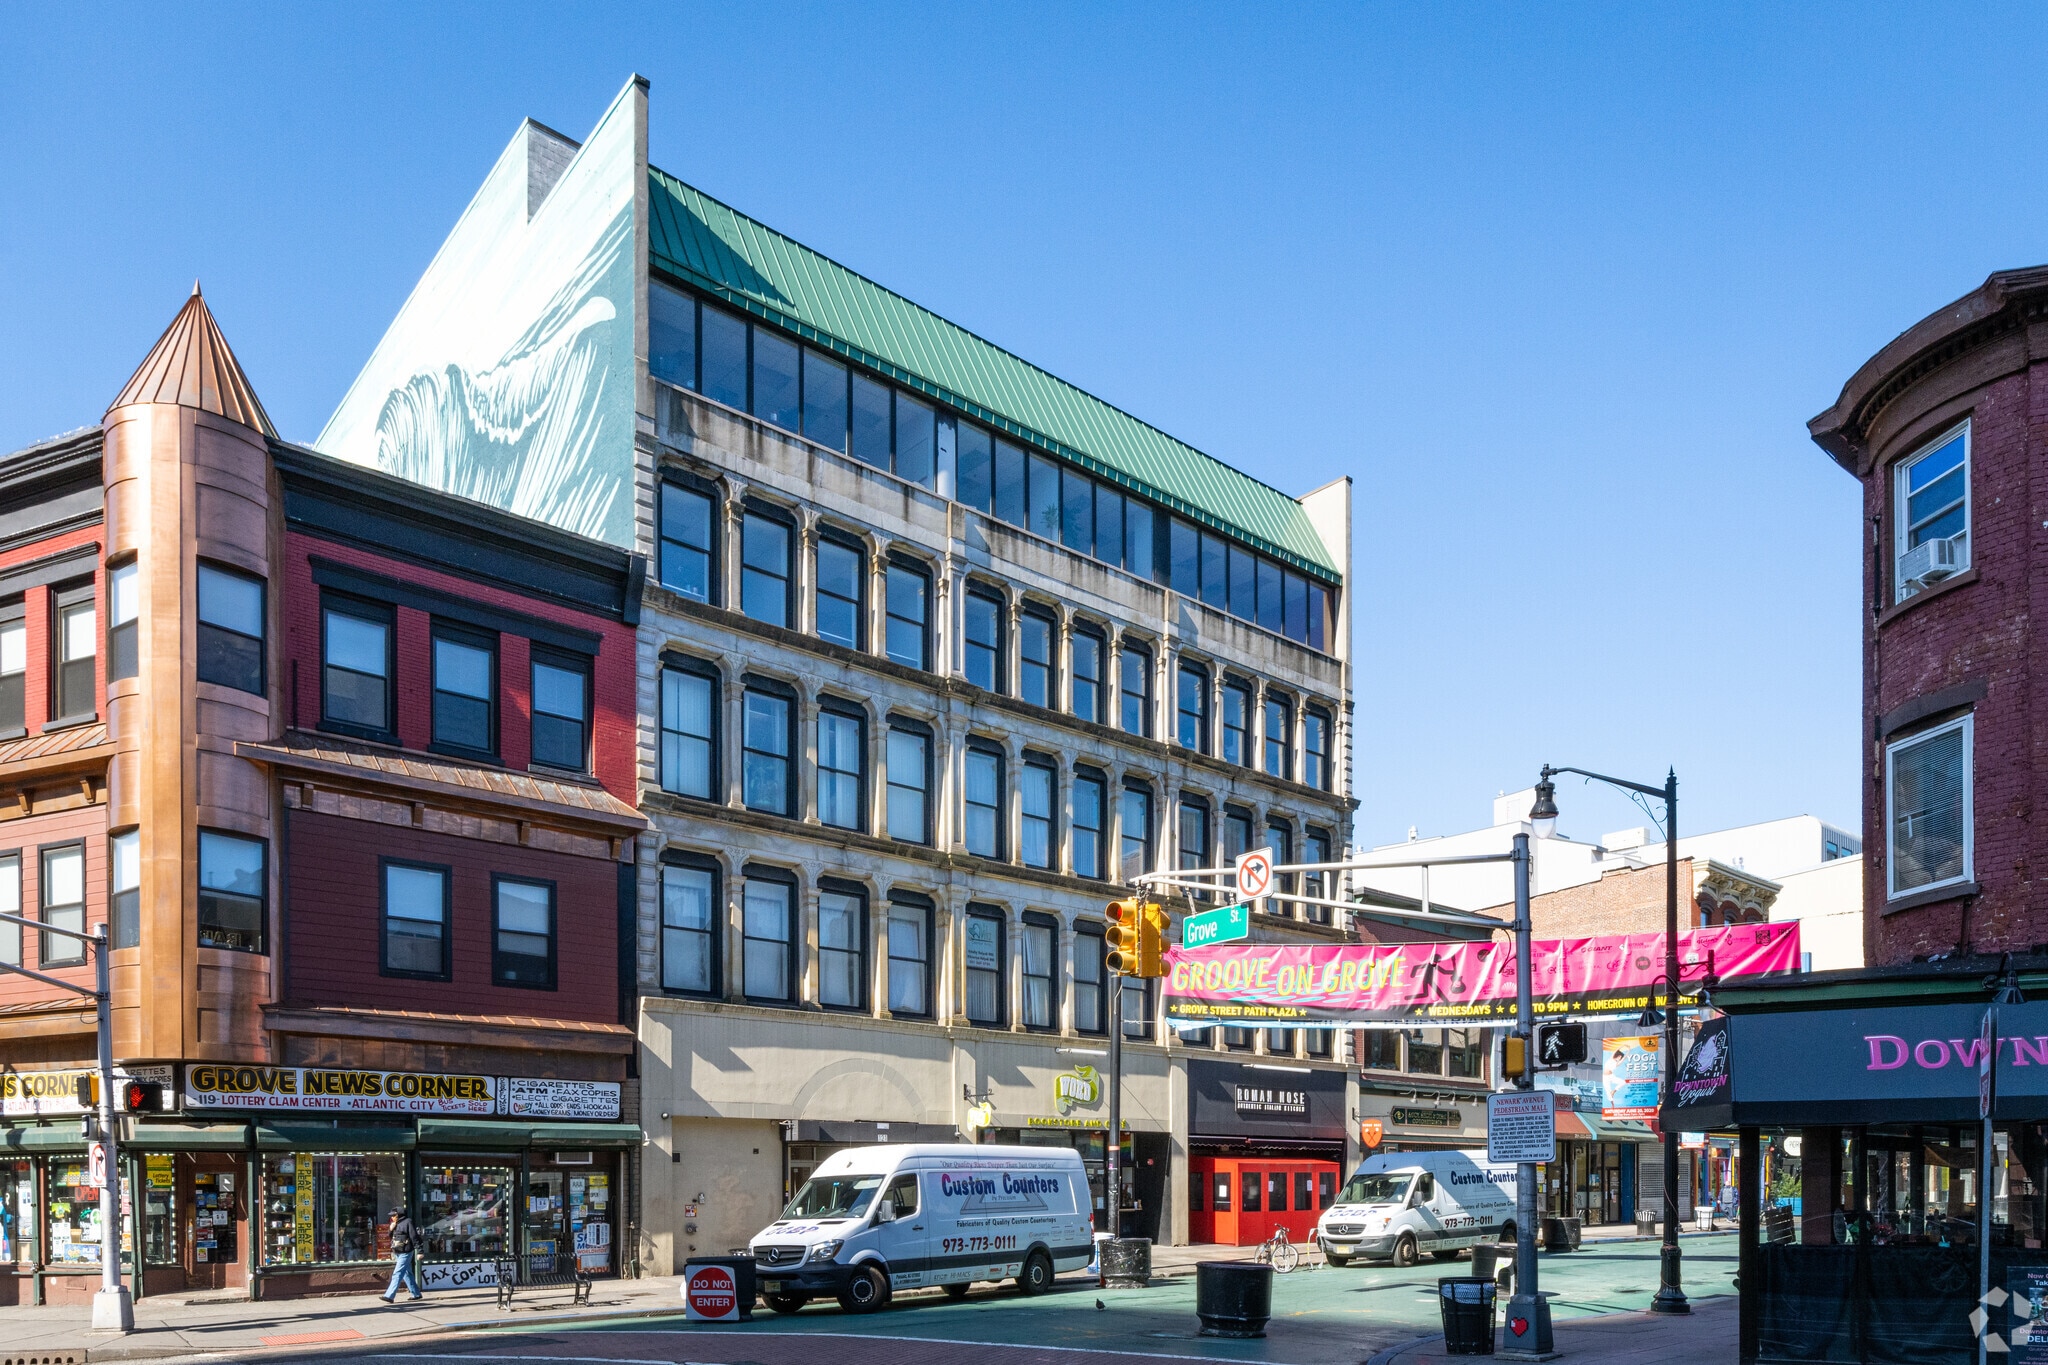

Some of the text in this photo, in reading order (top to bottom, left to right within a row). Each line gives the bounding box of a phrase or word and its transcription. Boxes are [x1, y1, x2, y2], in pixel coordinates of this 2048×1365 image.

[1187, 908, 1242, 944] Grove St.
[1172, 956, 1406, 996] GROOVE ON GROVE
[1180, 1004, 1297, 1018] GROVE STREET PATH PLAZA
[1428, 1005, 1491, 1016] WEDNESDAYS
[1533, 1001, 1568, 1013] TO 9PM
[1587, 998, 1636, 1010] HOMEGROWN
[1628, 1053, 1656, 1062] YOGA
[1627, 1062, 1656, 1071] FEST
[22, 1073, 79, 1098] CORNE
[191, 1065, 297, 1095] GROVE
[303, 1069, 382, 1096] NEWS
[384, 1073, 495, 1101] CORNER
[517, 1080, 594, 1089] CIGARETTES
[1060, 1076, 1091, 1101] WORD
[1674, 1075, 1728, 1092] DOWNTOWN
[551, 1096, 619, 1104] CIGARETTES
[581, 1089, 617, 1097] COPIES
[1237, 1088, 1305, 1104] ROMAN NOSE
[1678, 1083, 1717, 1107] Yogurt
[222, 1095, 266, 1106] LOTTERY
[268, 1096, 298, 1107] CLAM
[302, 1097, 340, 1107] CENTER
[352, 1099, 405, 1110] ATLANTIC
[410, 1101, 435, 1110] CITY
[442, 1103, 466, 1111] TICKETS
[1494, 1105, 1529, 1113] PEDESTRIAN
[1028, 1118, 1081, 1127] BOOKSTORE
[1084, 1119, 1101, 1128] AND
[297, 1169, 305, 1191] HERE
[304, 1169, 312, 1191] PLAY
[941, 1171, 1059, 1197] Custom Counters
[1451, 1170, 1484, 1186] Custom
[75, 1187, 99, 1201] OPEN
[992, 1219, 1010, 1227] Quality
[1445, 1216, 1493, 1228] 973-773-0111
[304, 1223, 312, 1244] PLAY
[943, 1235, 1016, 1253] 973-773-0111
[422, 1267, 450, 1286] FAX
[452, 1264, 482, 1286] COPY
[693, 1280, 731, 1288] DO NOT
[697, 1298, 730, 1306] ENTER
